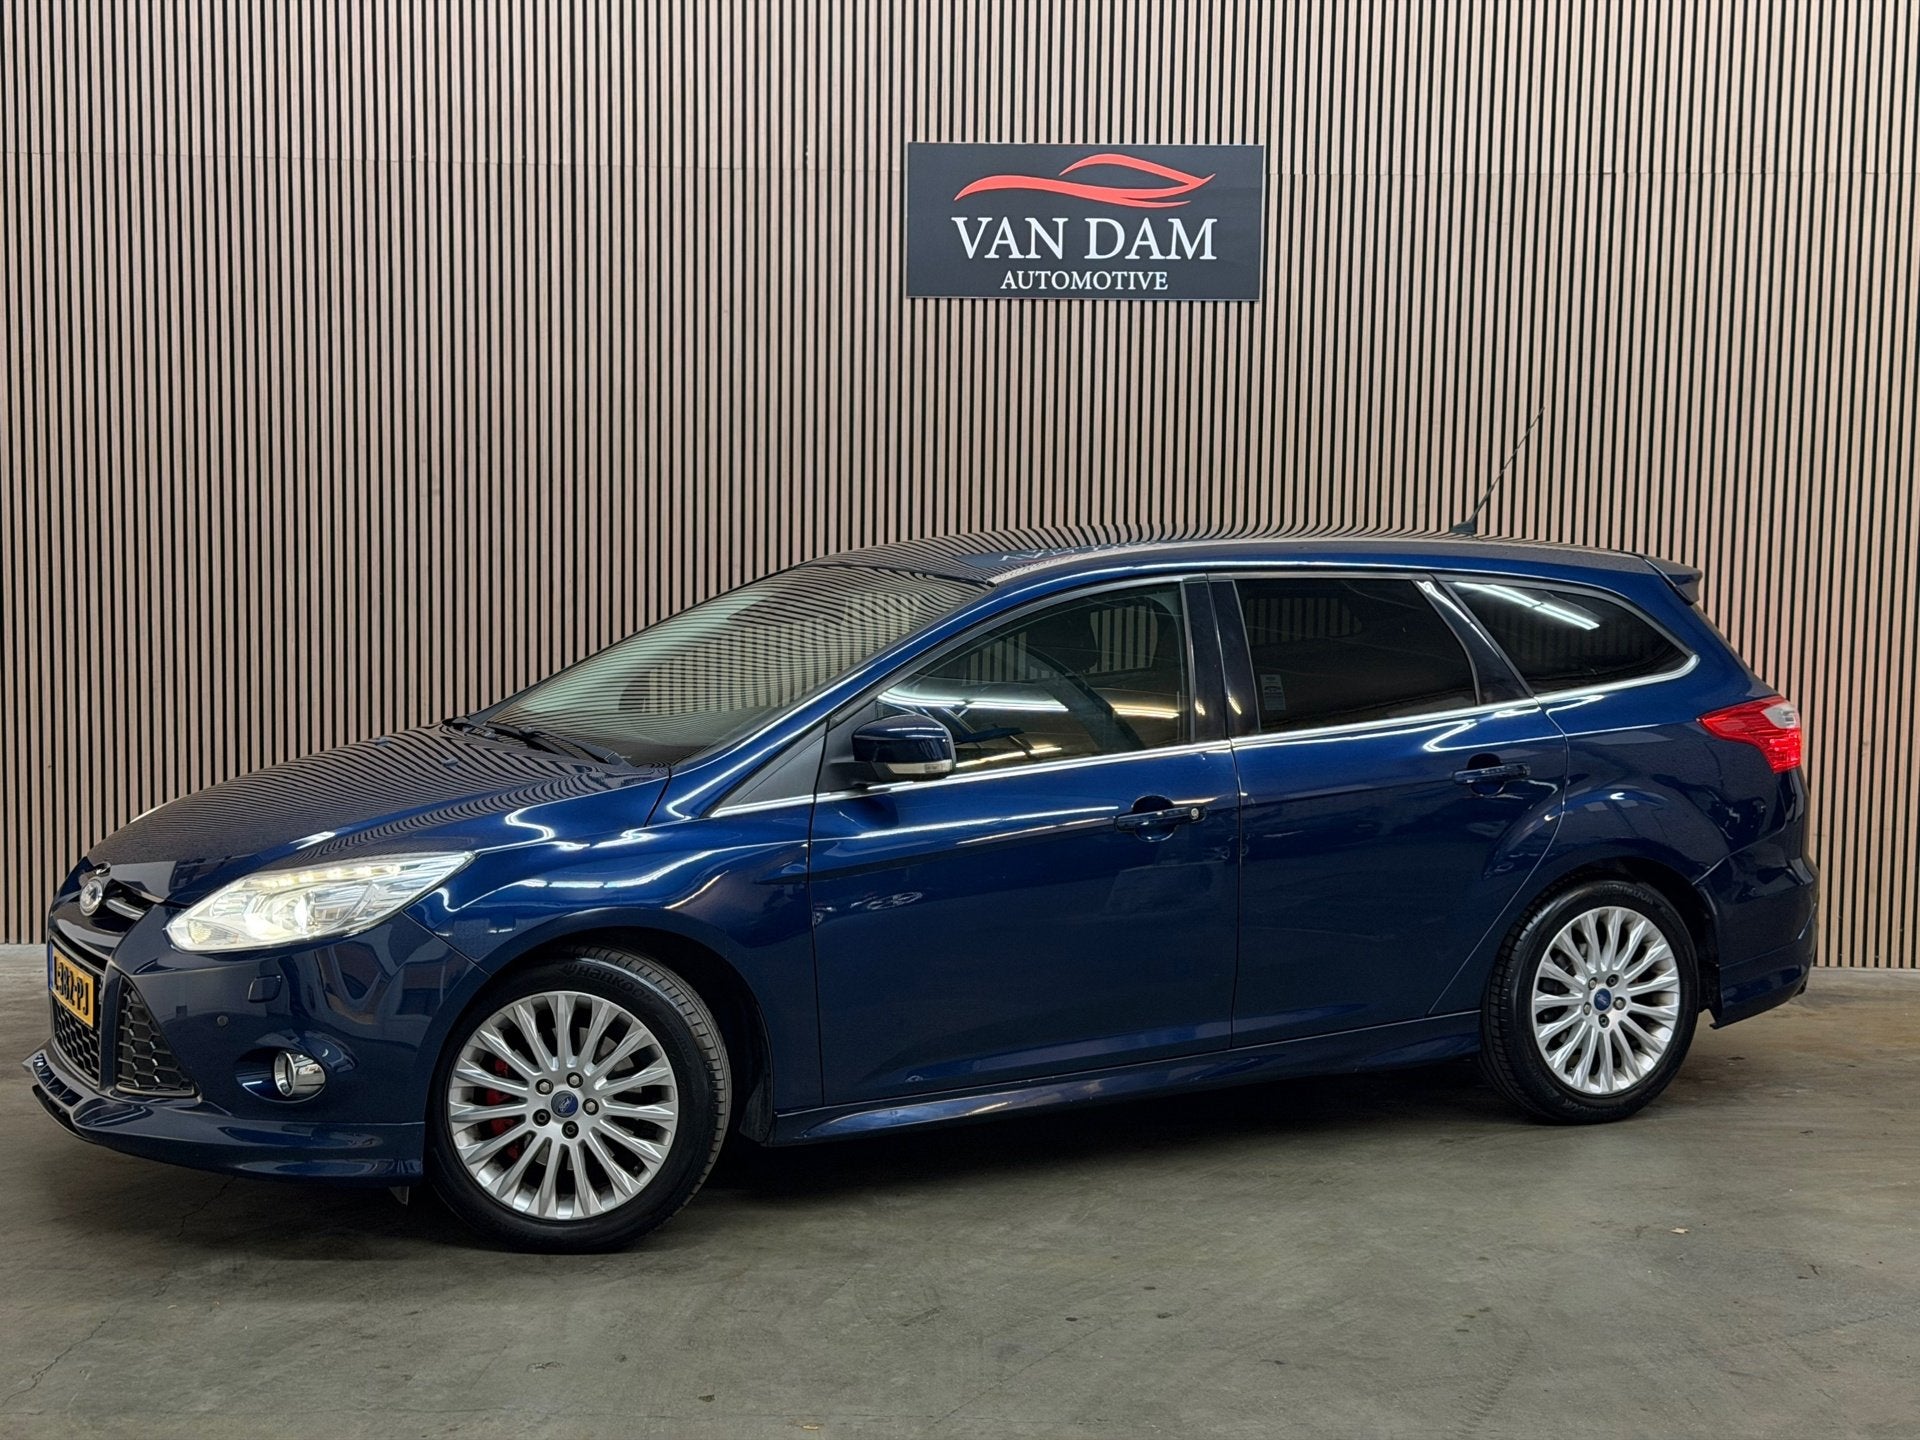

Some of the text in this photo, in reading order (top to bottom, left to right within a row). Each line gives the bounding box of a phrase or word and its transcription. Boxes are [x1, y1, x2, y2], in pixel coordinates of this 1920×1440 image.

[951, 216, 1218, 260] VAN DAM
[1000, 270, 1169, 291] AUTOMOTIVE
